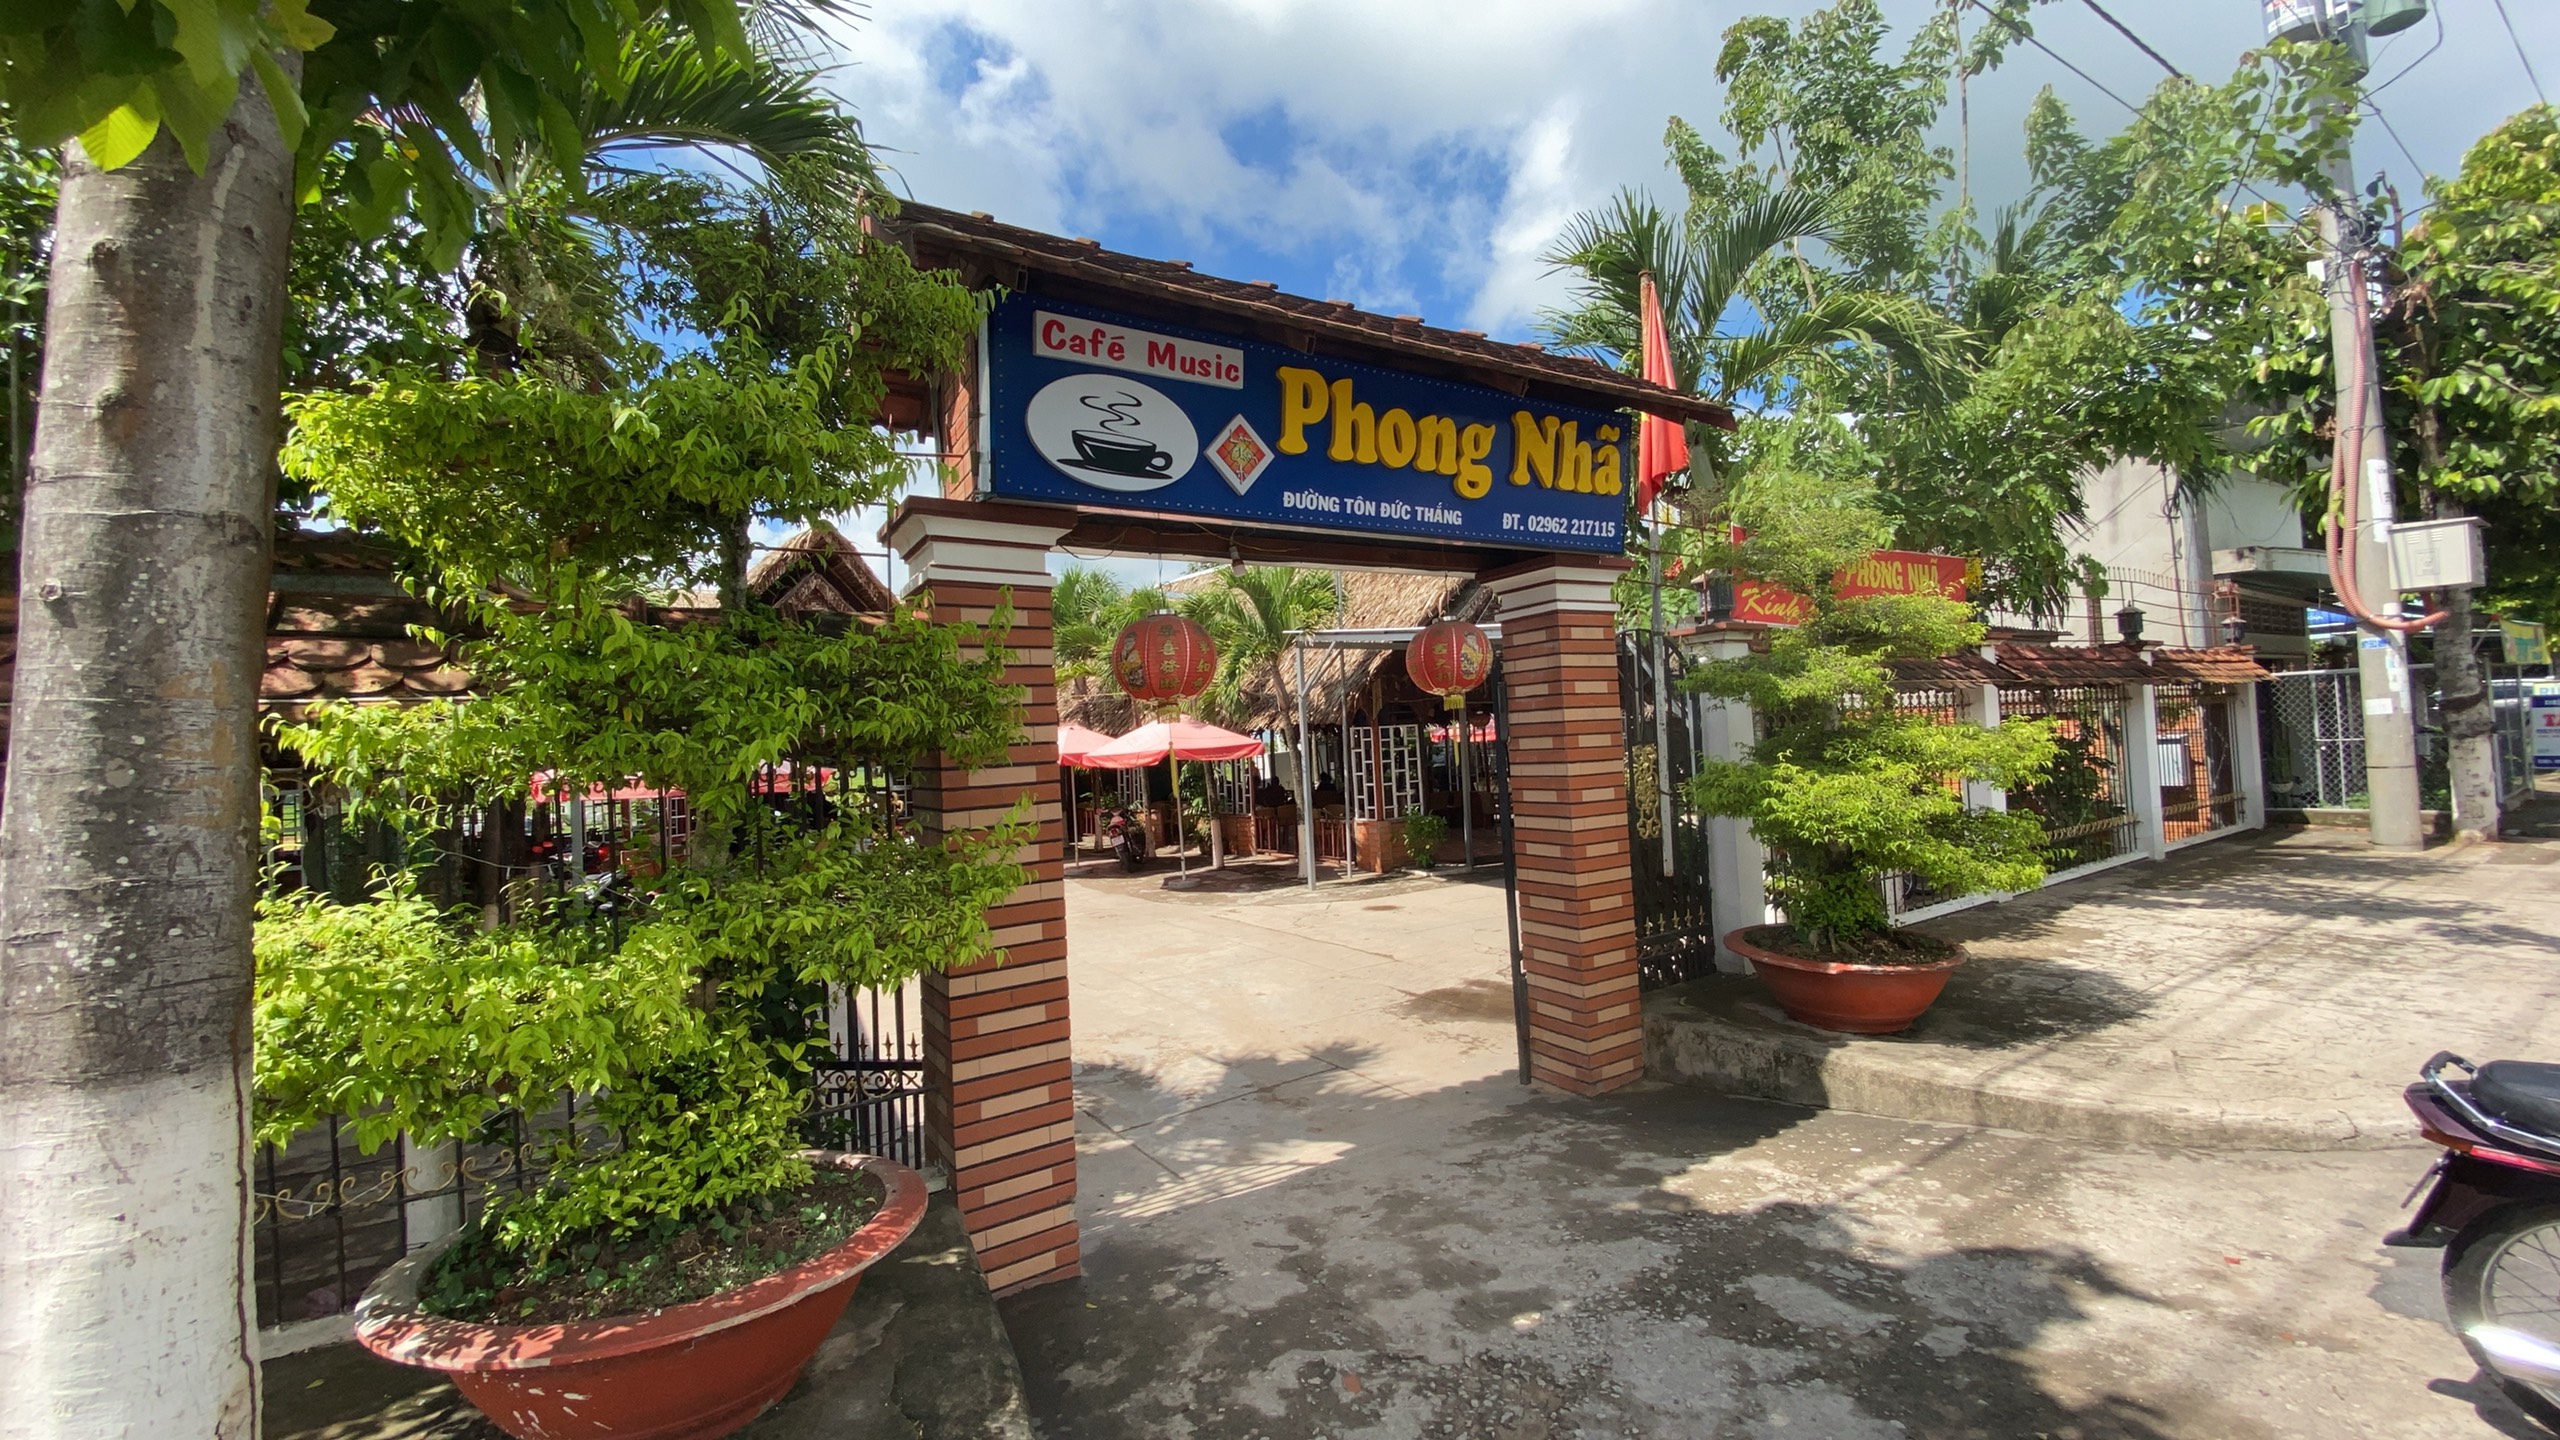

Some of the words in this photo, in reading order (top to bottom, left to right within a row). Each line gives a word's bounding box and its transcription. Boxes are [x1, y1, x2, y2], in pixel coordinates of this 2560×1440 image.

[1042, 319, 1126, 361] Café
[1147, 340, 1240, 383] Music
[1276, 366, 1496, 500] Phong
[1509, 410, 1622, 496] Nhã
[1283, 488, 1340, 513] ĐƯỜNG
[1344, 495, 1376, 516] TÔN
[1380, 499, 1411, 520] ĐỨC
[1415, 502, 1463, 525] THẮNG
[1502, 512, 1525, 531] ĐT.
[1528, 515, 1568, 534] 02962
[1570, 518, 1616, 537] 217115
[1845, 559, 1903, 591] PHONG
